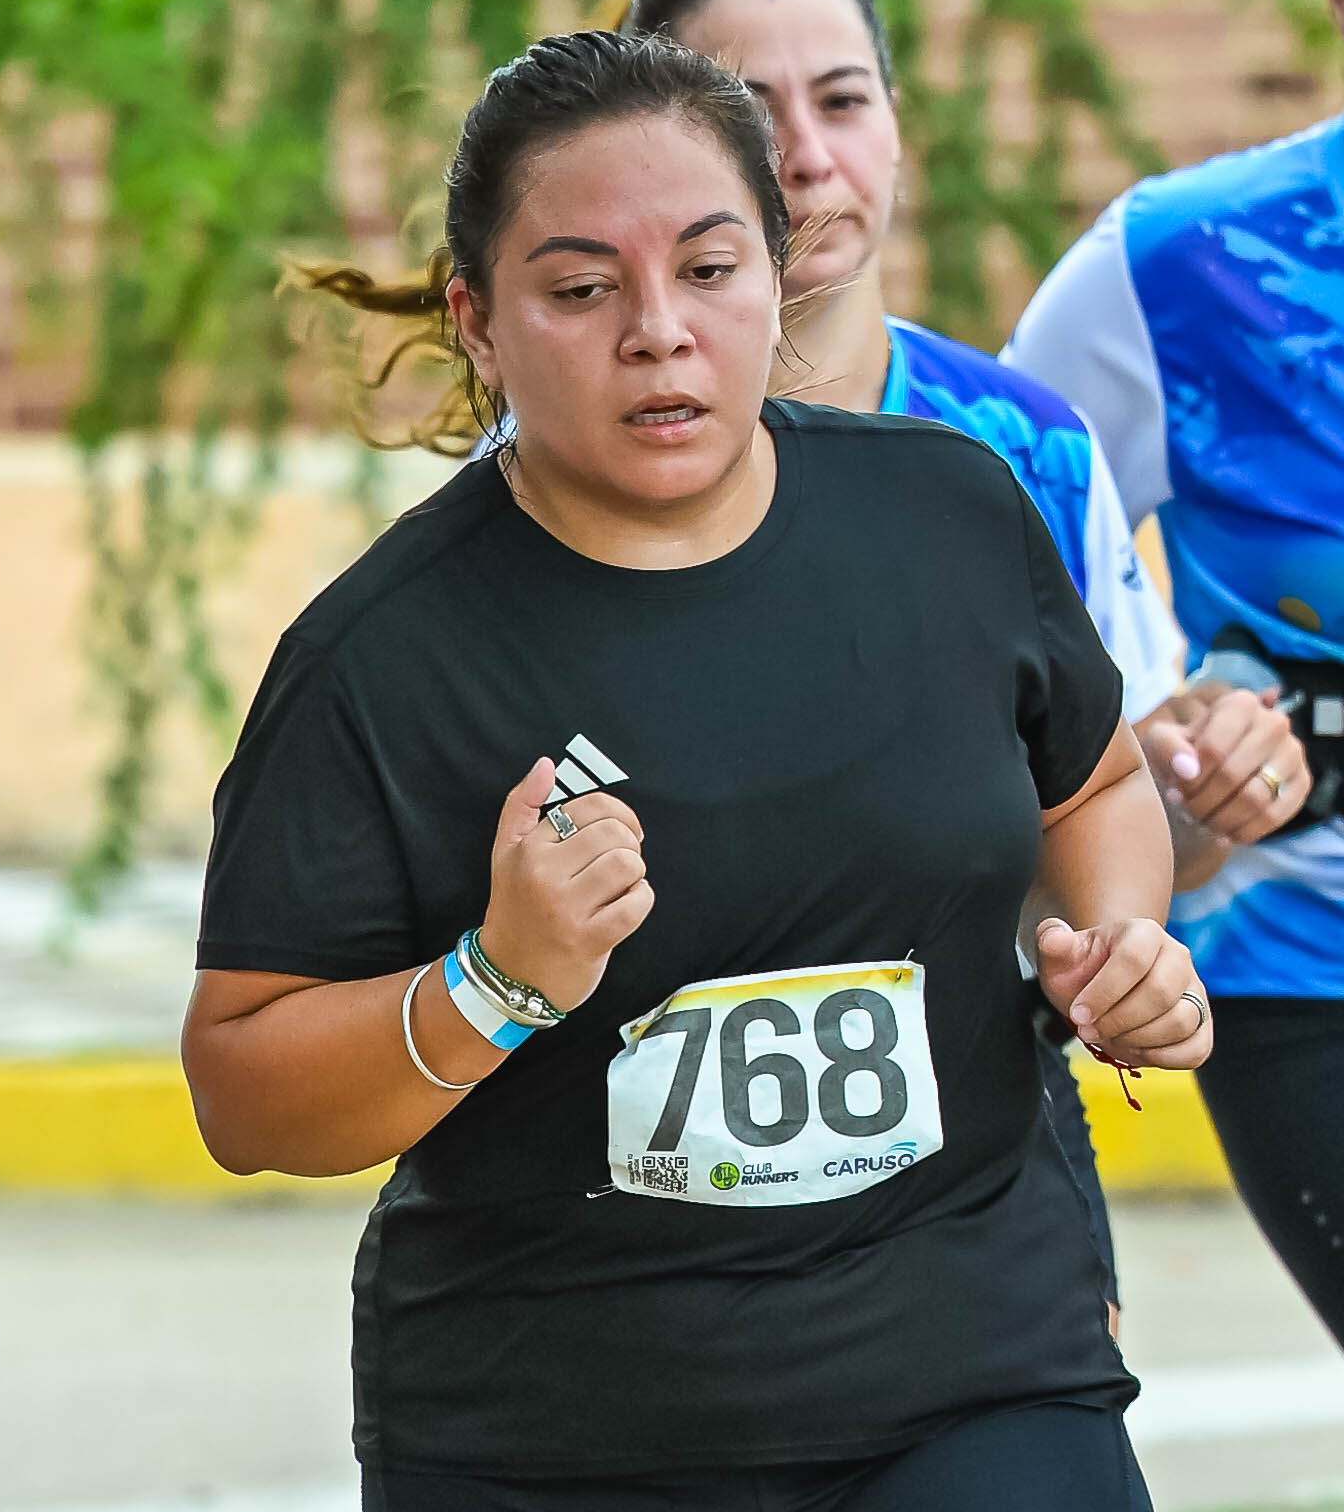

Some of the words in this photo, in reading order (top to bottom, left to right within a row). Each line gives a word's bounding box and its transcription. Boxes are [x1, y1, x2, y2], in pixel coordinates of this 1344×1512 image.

[638, 988, 908, 1152] 768
[742, 1162, 772, 1175] CLUB
[823, 1154, 914, 1177] CARUSO
